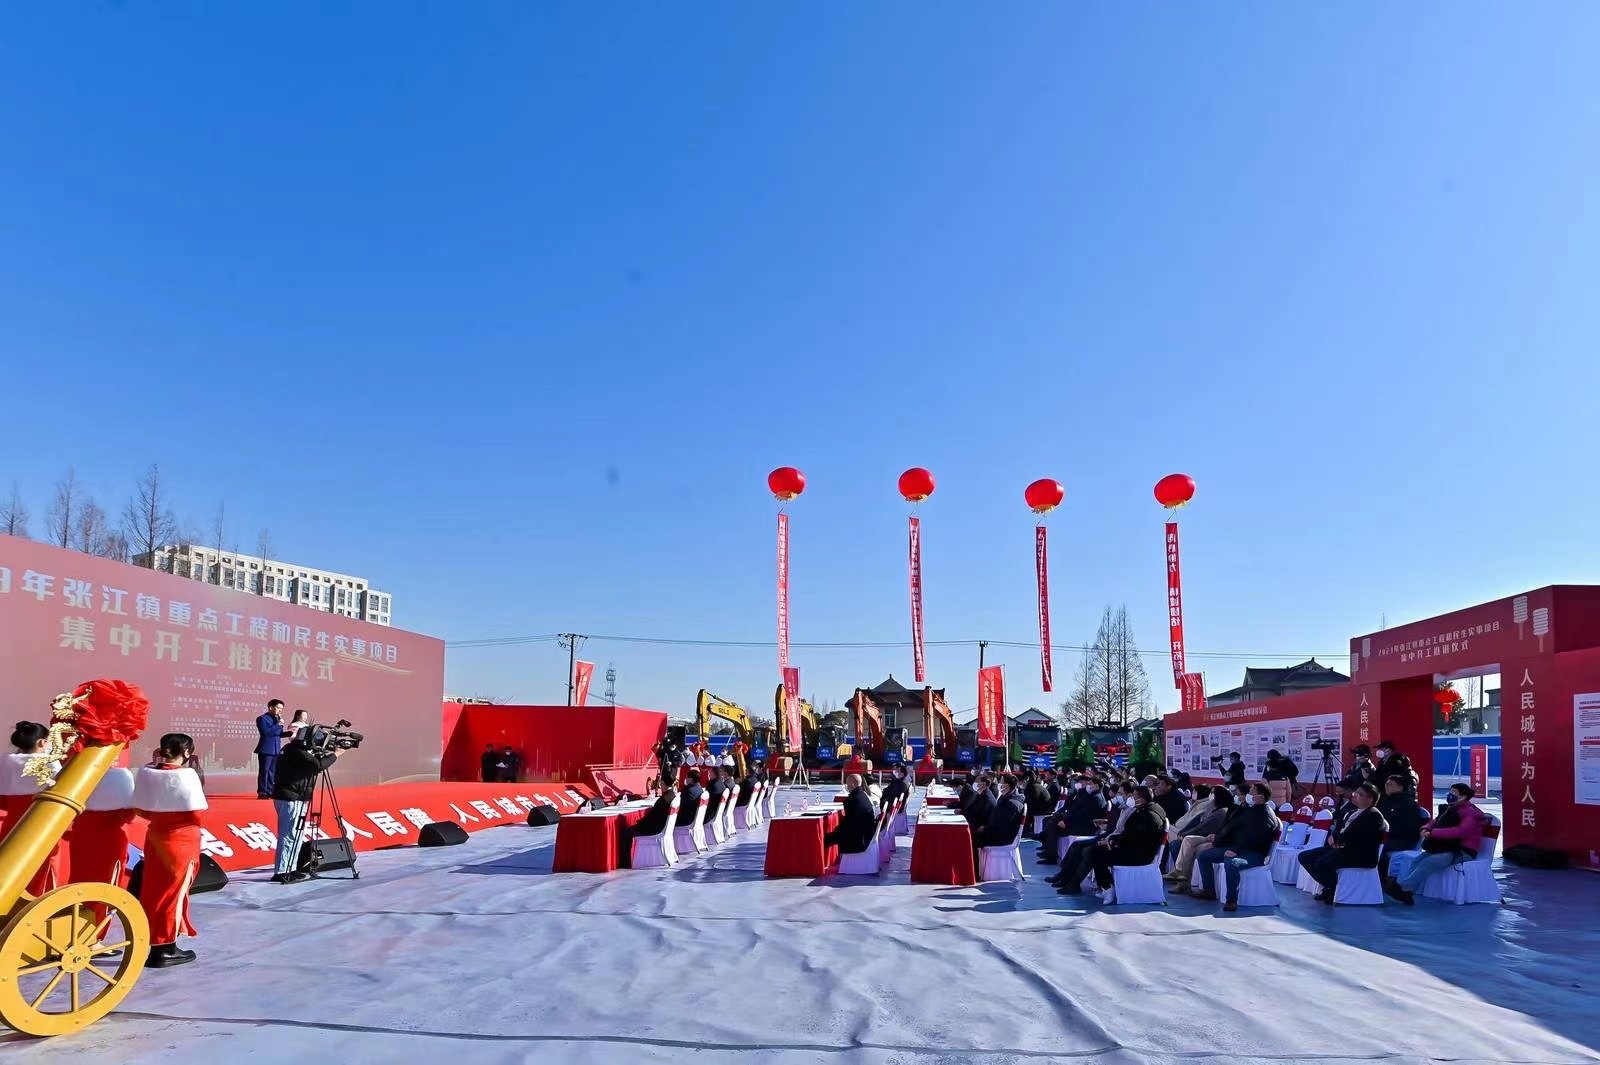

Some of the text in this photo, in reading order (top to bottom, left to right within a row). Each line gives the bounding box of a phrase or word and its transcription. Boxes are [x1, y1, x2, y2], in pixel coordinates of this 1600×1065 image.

[59, 615, 336, 683] 集中开工推进仪式
[1520, 668, 1536, 827] 人民城市为人民
